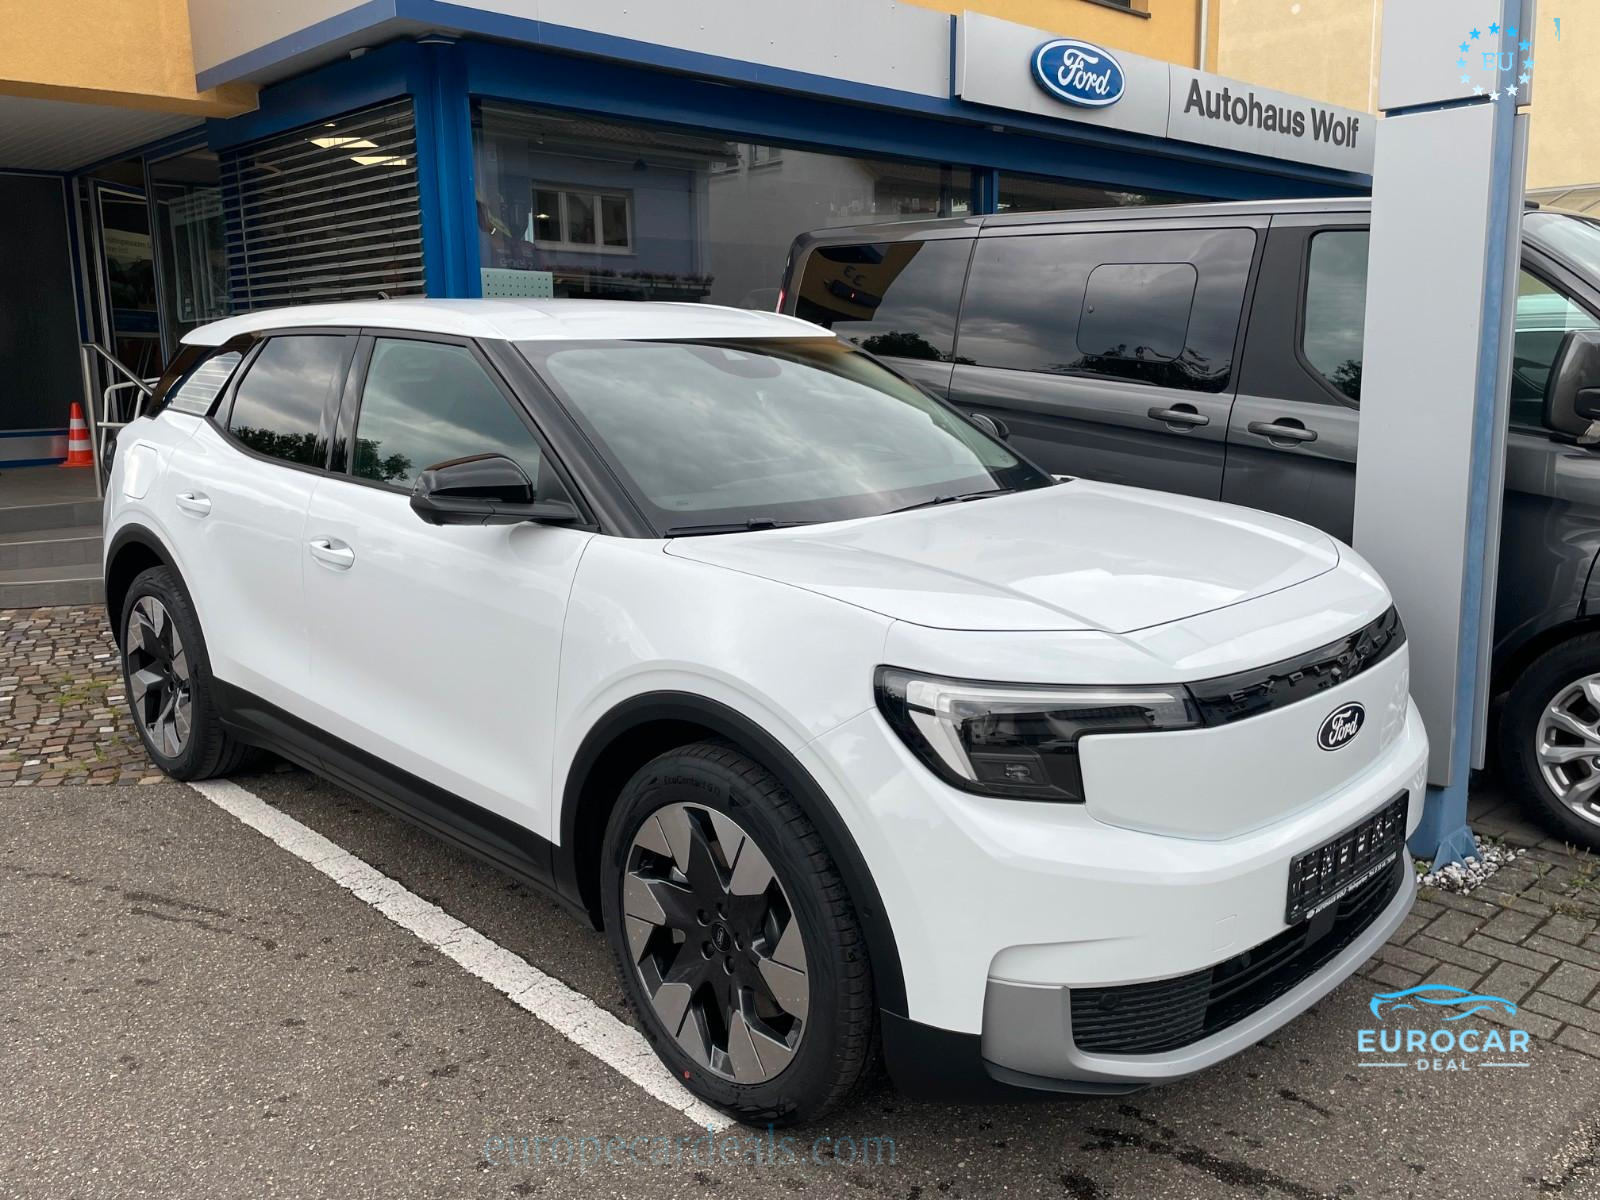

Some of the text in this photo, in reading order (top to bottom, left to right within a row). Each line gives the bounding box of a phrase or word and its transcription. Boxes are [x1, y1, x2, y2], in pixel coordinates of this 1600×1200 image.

[1057, 44, 1110, 95] Ford
[1183, 79, 1359, 148] Autohaus Wolf
[1329, 710, 1358, 745] Ford
